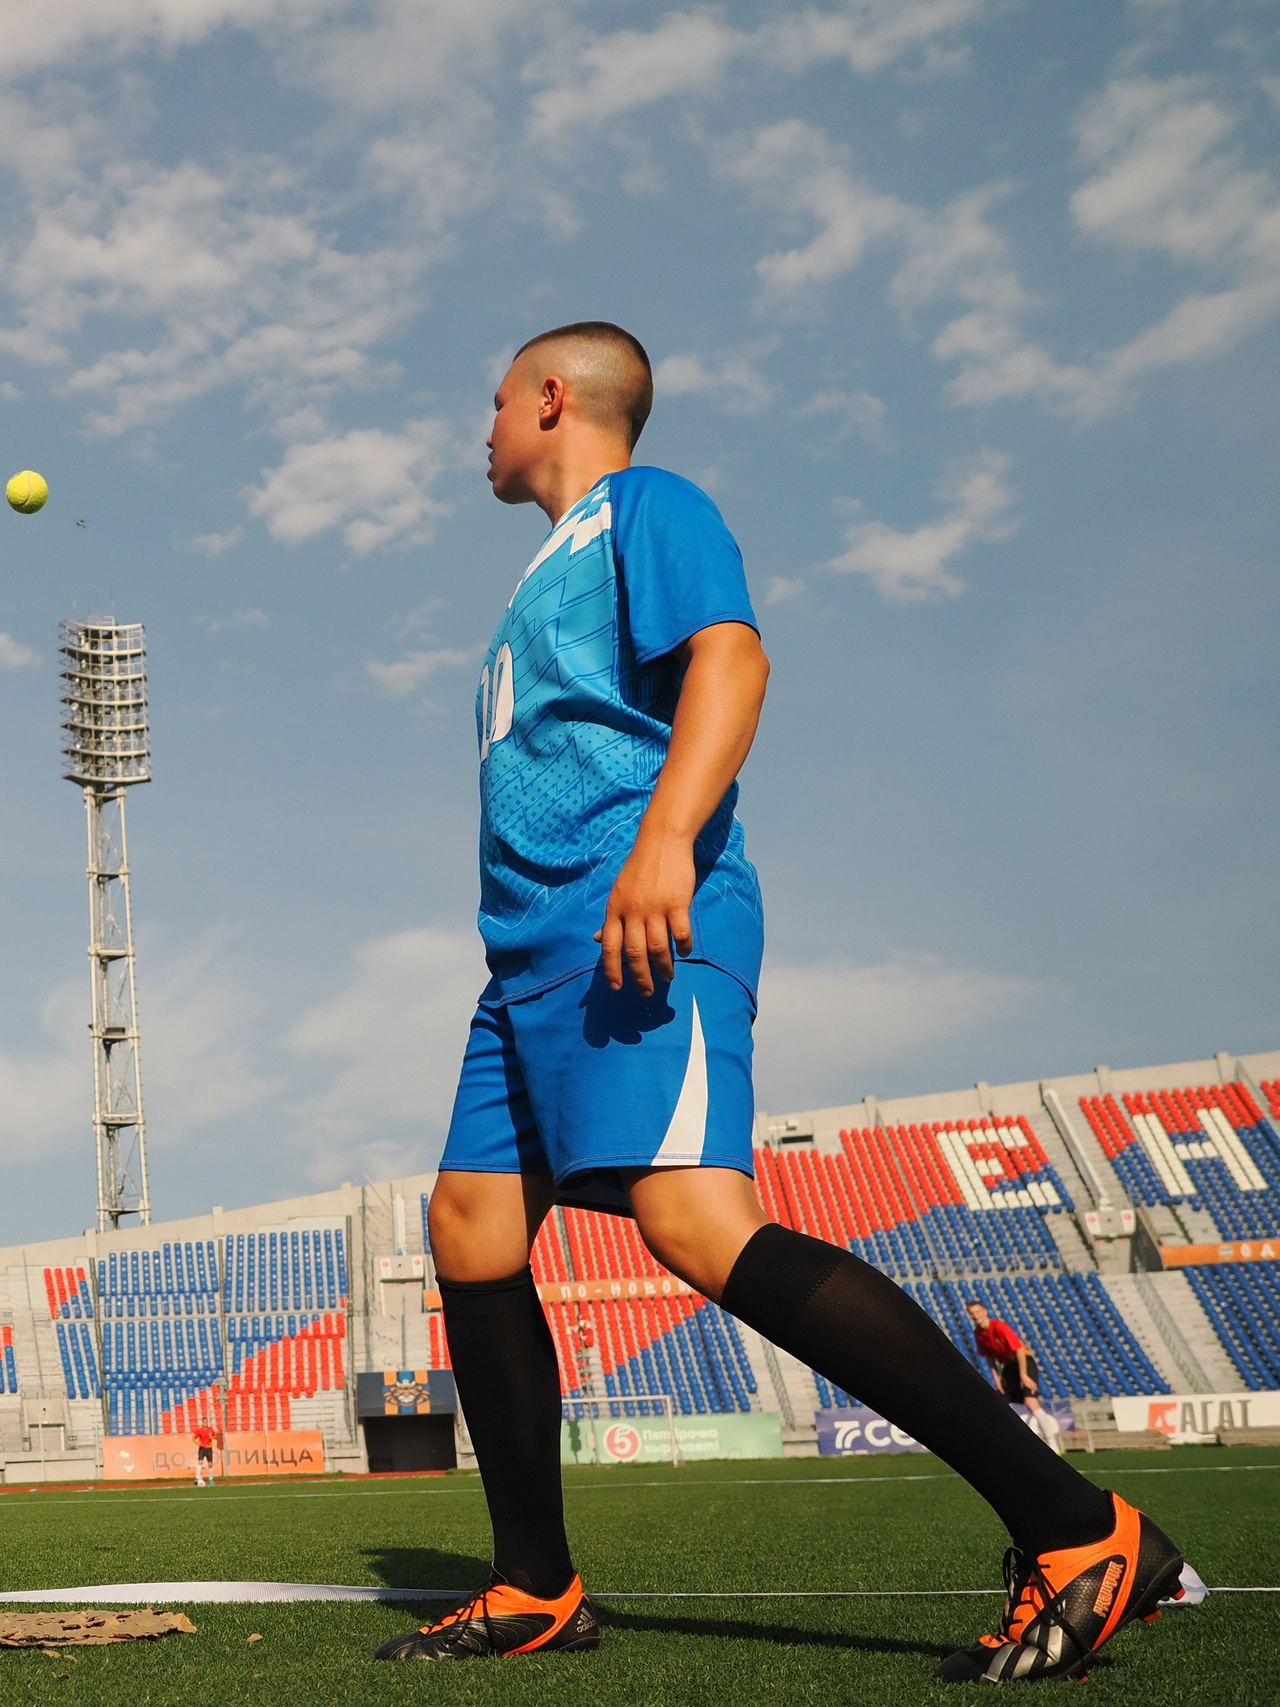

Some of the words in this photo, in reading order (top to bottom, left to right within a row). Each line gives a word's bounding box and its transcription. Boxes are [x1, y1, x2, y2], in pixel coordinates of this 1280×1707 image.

[480, 641, 515, 763] 10
[1180, 1399, 1252, 1433] АГАТ
[226, 1447, 313, 1467] ПИЦЦА
[644, 1440, 719, 1456] вырчает!
